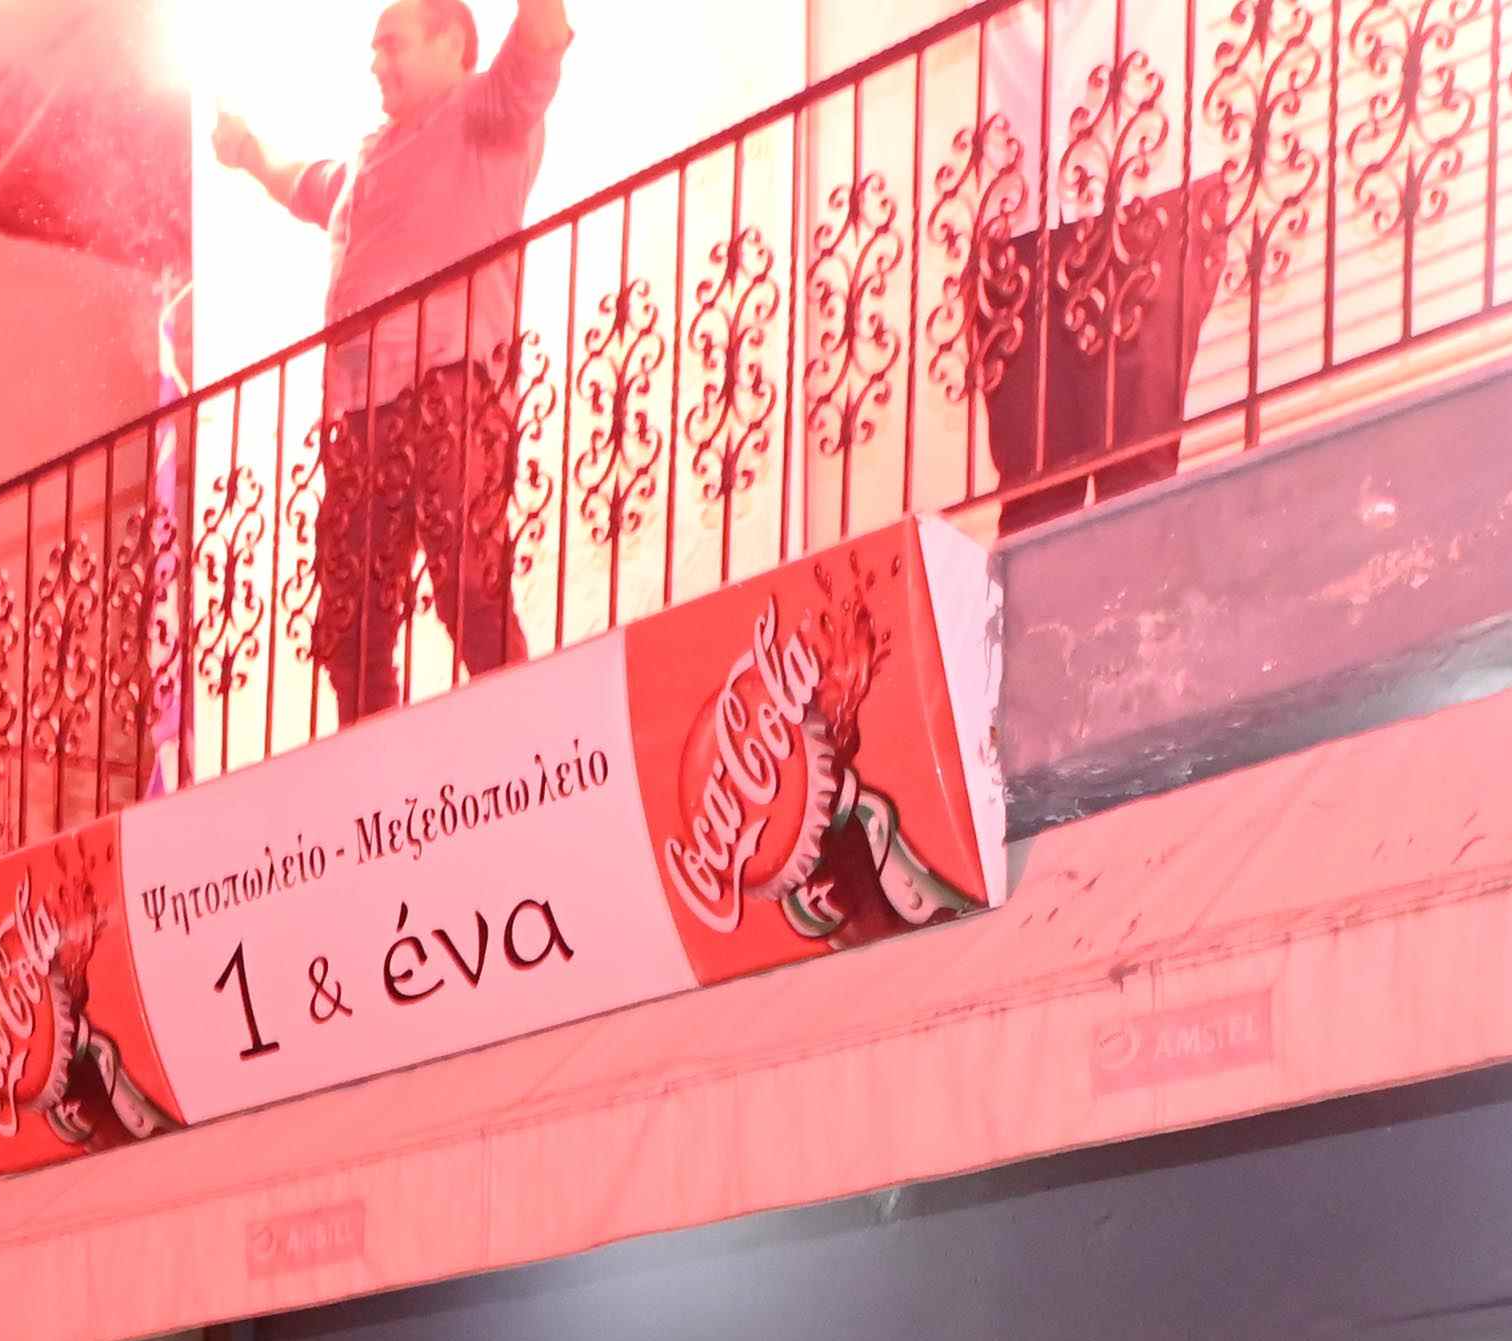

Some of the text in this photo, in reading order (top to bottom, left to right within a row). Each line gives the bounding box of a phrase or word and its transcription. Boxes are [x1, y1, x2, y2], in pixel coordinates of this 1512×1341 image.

[141, 835, 326, 935] Ψητοπωλείο
[354, 738, 609, 866] Μεζεδοπωλείο
[665, 594, 819, 933] Coca-Cola
[214, 901, 575, 1061] 1 & ένα
